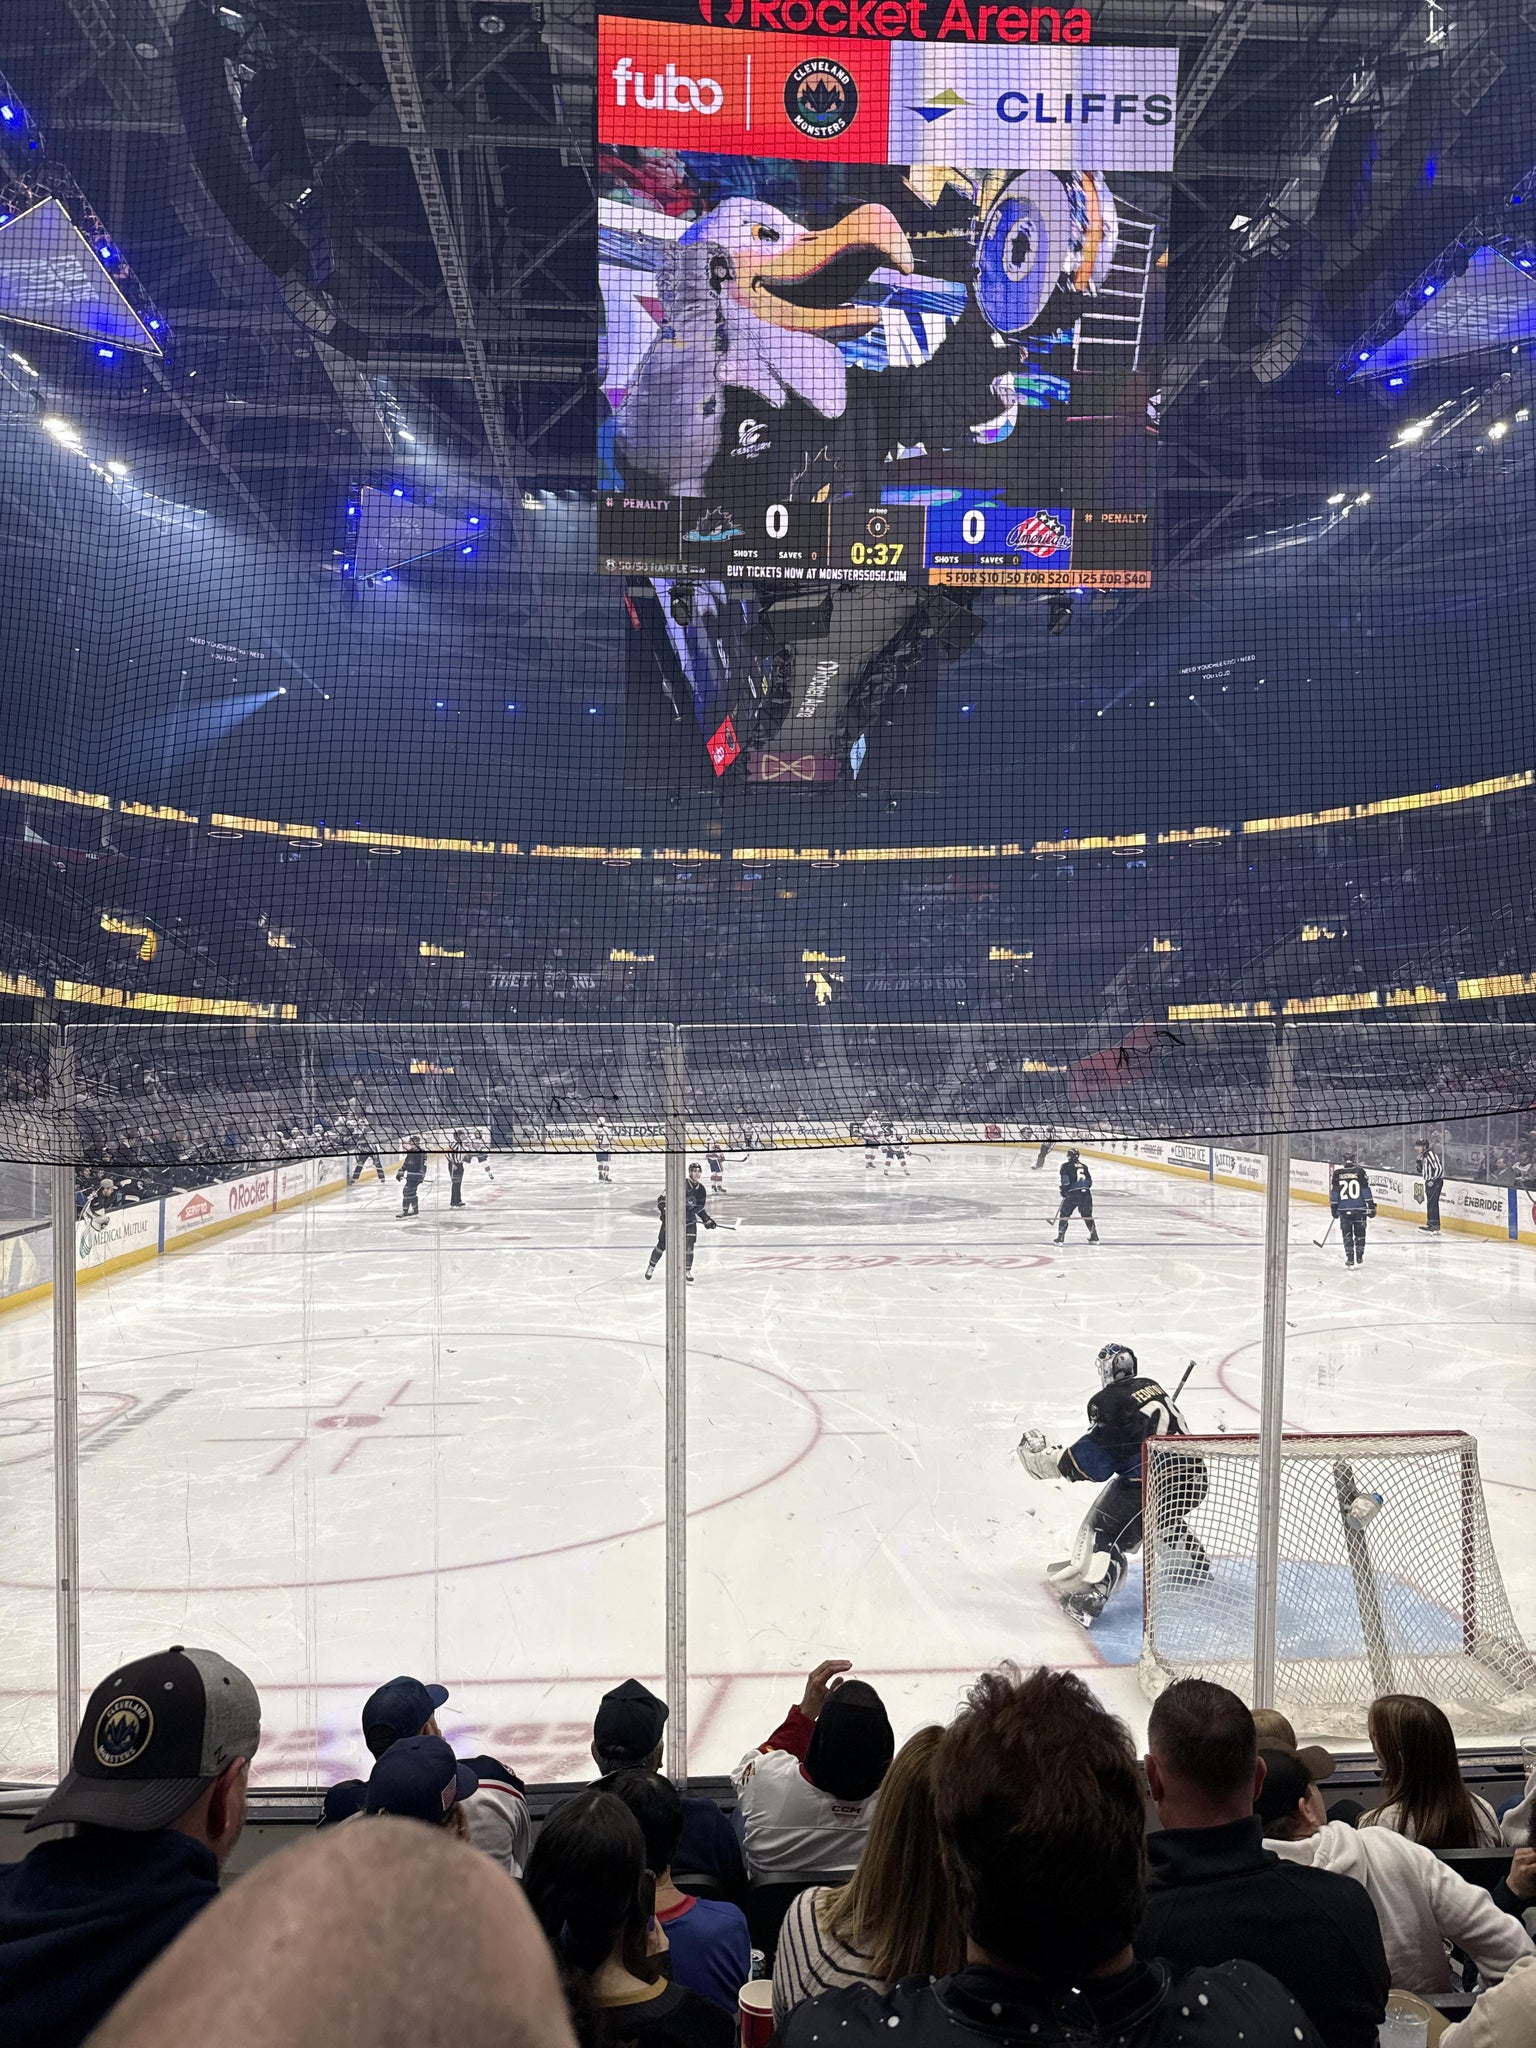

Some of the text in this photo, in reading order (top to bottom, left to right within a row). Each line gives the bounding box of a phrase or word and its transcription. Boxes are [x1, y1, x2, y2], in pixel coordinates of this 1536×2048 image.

[751, 0, 1092, 44] Rocket Arena
[793, 61, 850, 85] CLEVELAND
[611, 57, 723, 116] fubo
[995, 90, 1174, 125] CLIFFS
[793, 114, 846, 136] MONSTERS
[623, 498, 670, 511] PENALTY
[765, 504, 789, 540] 0
[962, 509, 985, 545] 0
[1101, 513, 1148, 524] PENALTY
[1006, 524, 1073, 549] Americans
[733, 550, 759, 558] SHOTS
[778, 551, 803, 560] SAVES
[850, 542, 904, 566] 0:37
[934, 555, 960, 564] SHOTS
[979, 556, 1004, 565] SAVES
[726, 565, 907, 582] BUY TICKETS NOW AT MONSTERS5050.COM
[945, 572, 1146, 586] 5 FOR $10 50 FOR $20 125 FOR $40
[1174, 1145, 1196, 1161] CENTER
[1196, 1148, 1206, 1162] ICE
[1076, 1167, 1087, 1182] 6
[237, 1176, 269, 1210] Rocket
[1338, 1179, 1361, 1201] 20
[1464, 1195, 1504, 1213] ENBRIDGE
[93, 1227, 122, 1247] MEDICAL
[106, 1700, 147, 1719] CLEVELAND
[99, 1744, 136, 1763] MONSTERS
[831, 1805, 863, 1814] CCM
